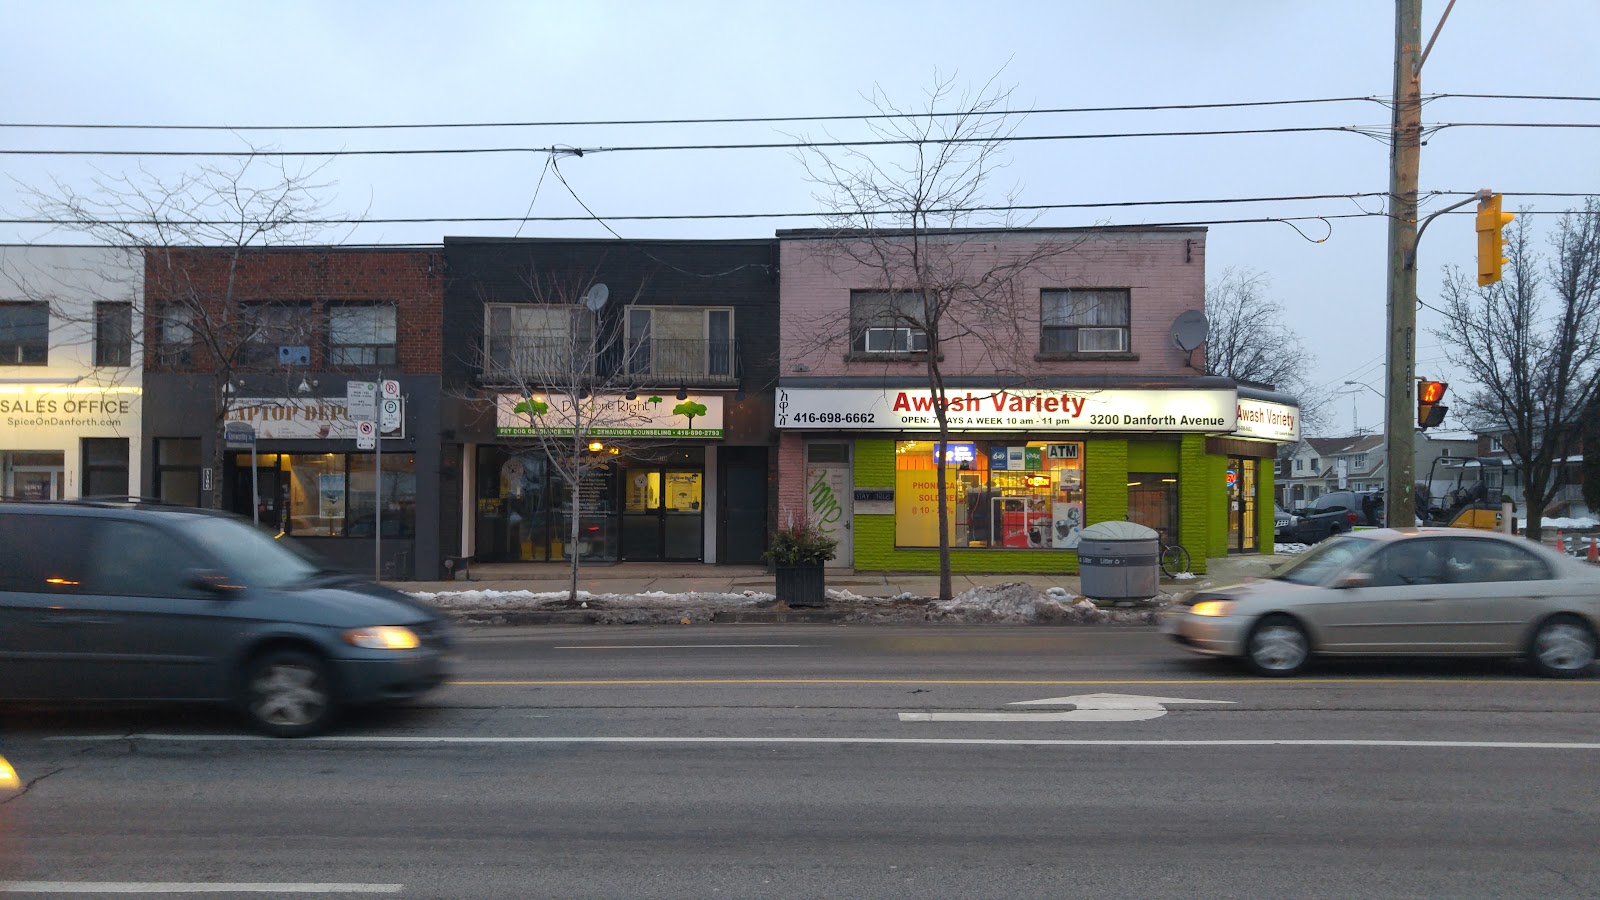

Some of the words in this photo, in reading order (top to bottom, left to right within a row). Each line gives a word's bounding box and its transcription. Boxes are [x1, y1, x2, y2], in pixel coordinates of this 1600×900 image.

[0, 400, 57, 414] SALES
[63, 400, 129, 414] OFFICE
[617, 399, 650, 416] Right
[893, 392, 980, 412] Awash
[991, 392, 1086, 418] Variety
[7, 417, 121, 428] SpiceOnDanforth.com
[793, 412, 875, 423] 416-698-6662
[901, 416, 930, 424] OPEN:
[1090, 414, 1119, 425] 3200
[1123, 414, 1176, 425] Danforth
[1180, 415, 1225, 426] Avenue
[1236, 404, 1264, 423] Awash
[1266, 408, 1295, 431] Variety
[1050, 445, 1076, 457] ATM
